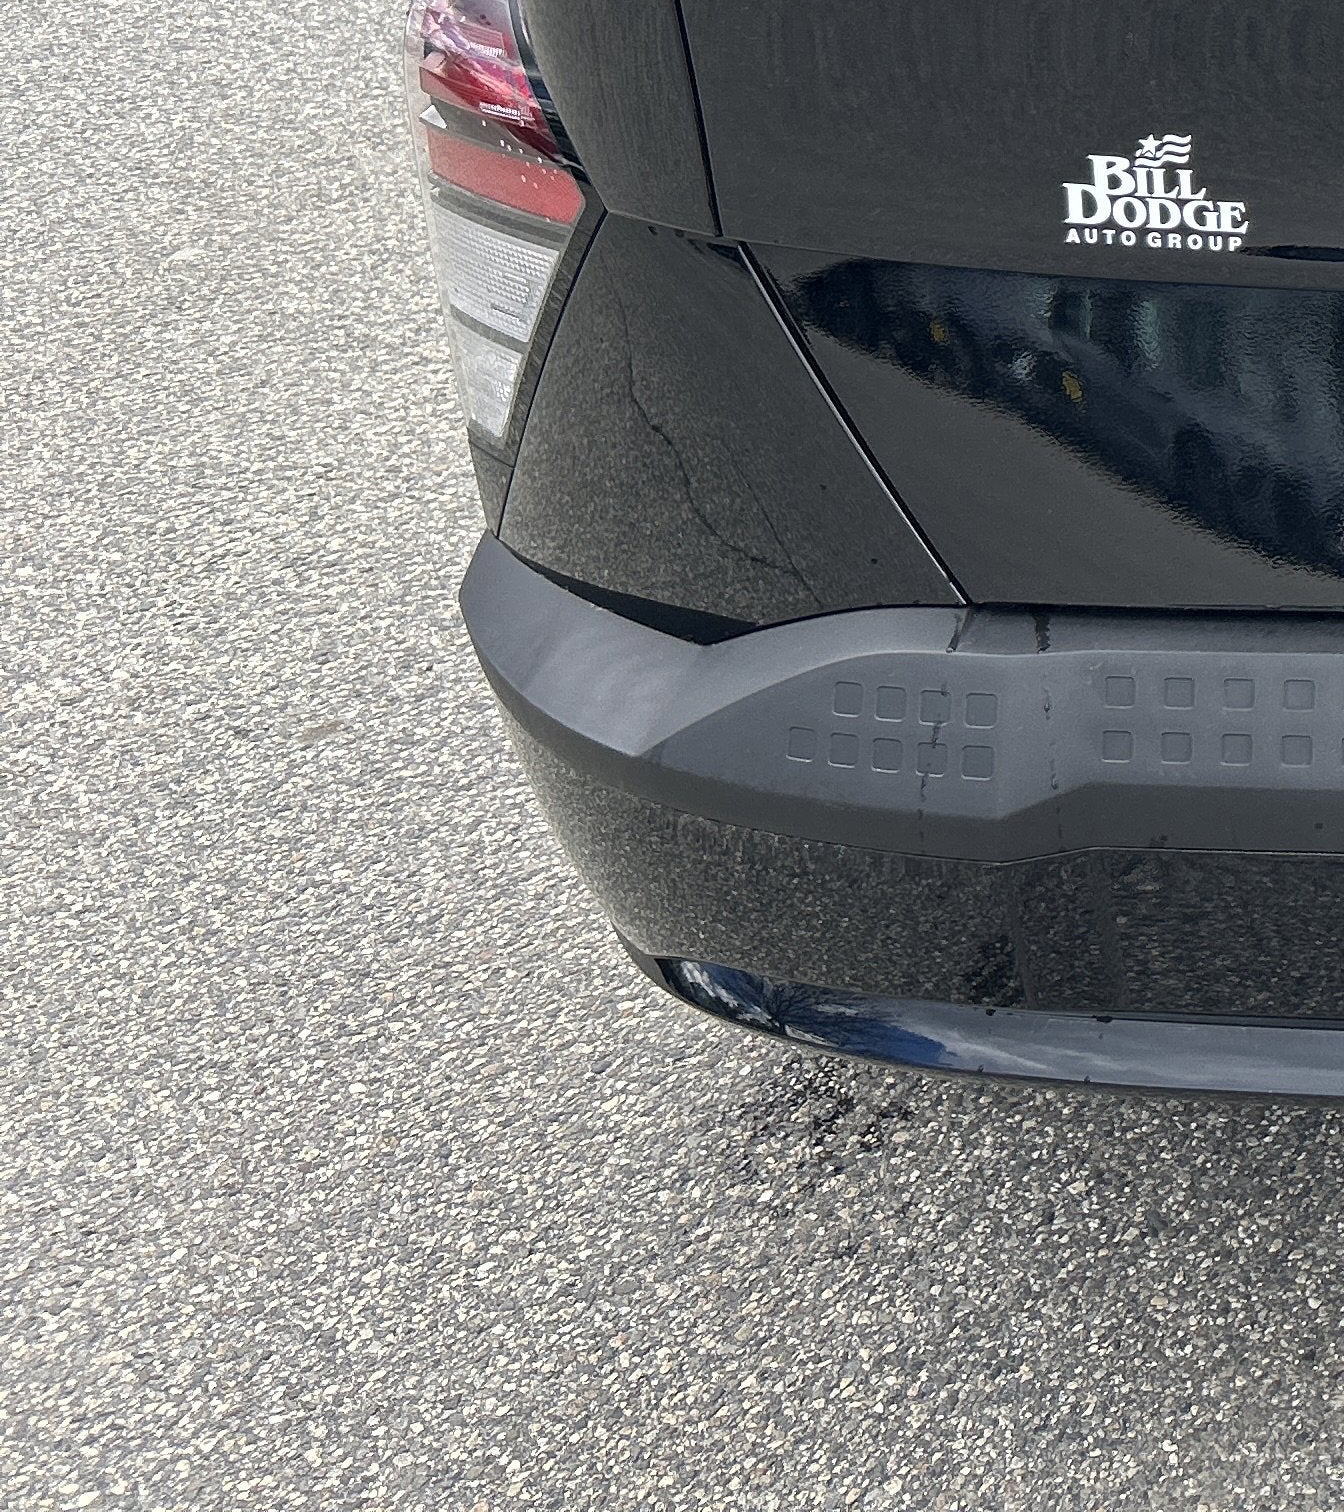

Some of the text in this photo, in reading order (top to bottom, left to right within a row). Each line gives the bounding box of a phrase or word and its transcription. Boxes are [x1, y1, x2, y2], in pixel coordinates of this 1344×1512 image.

[1086, 154, 1207, 200] BILL
[1062, 182, 1249, 234] DODGE
[1064, 228, 1243, 252] AUTO GROUP
